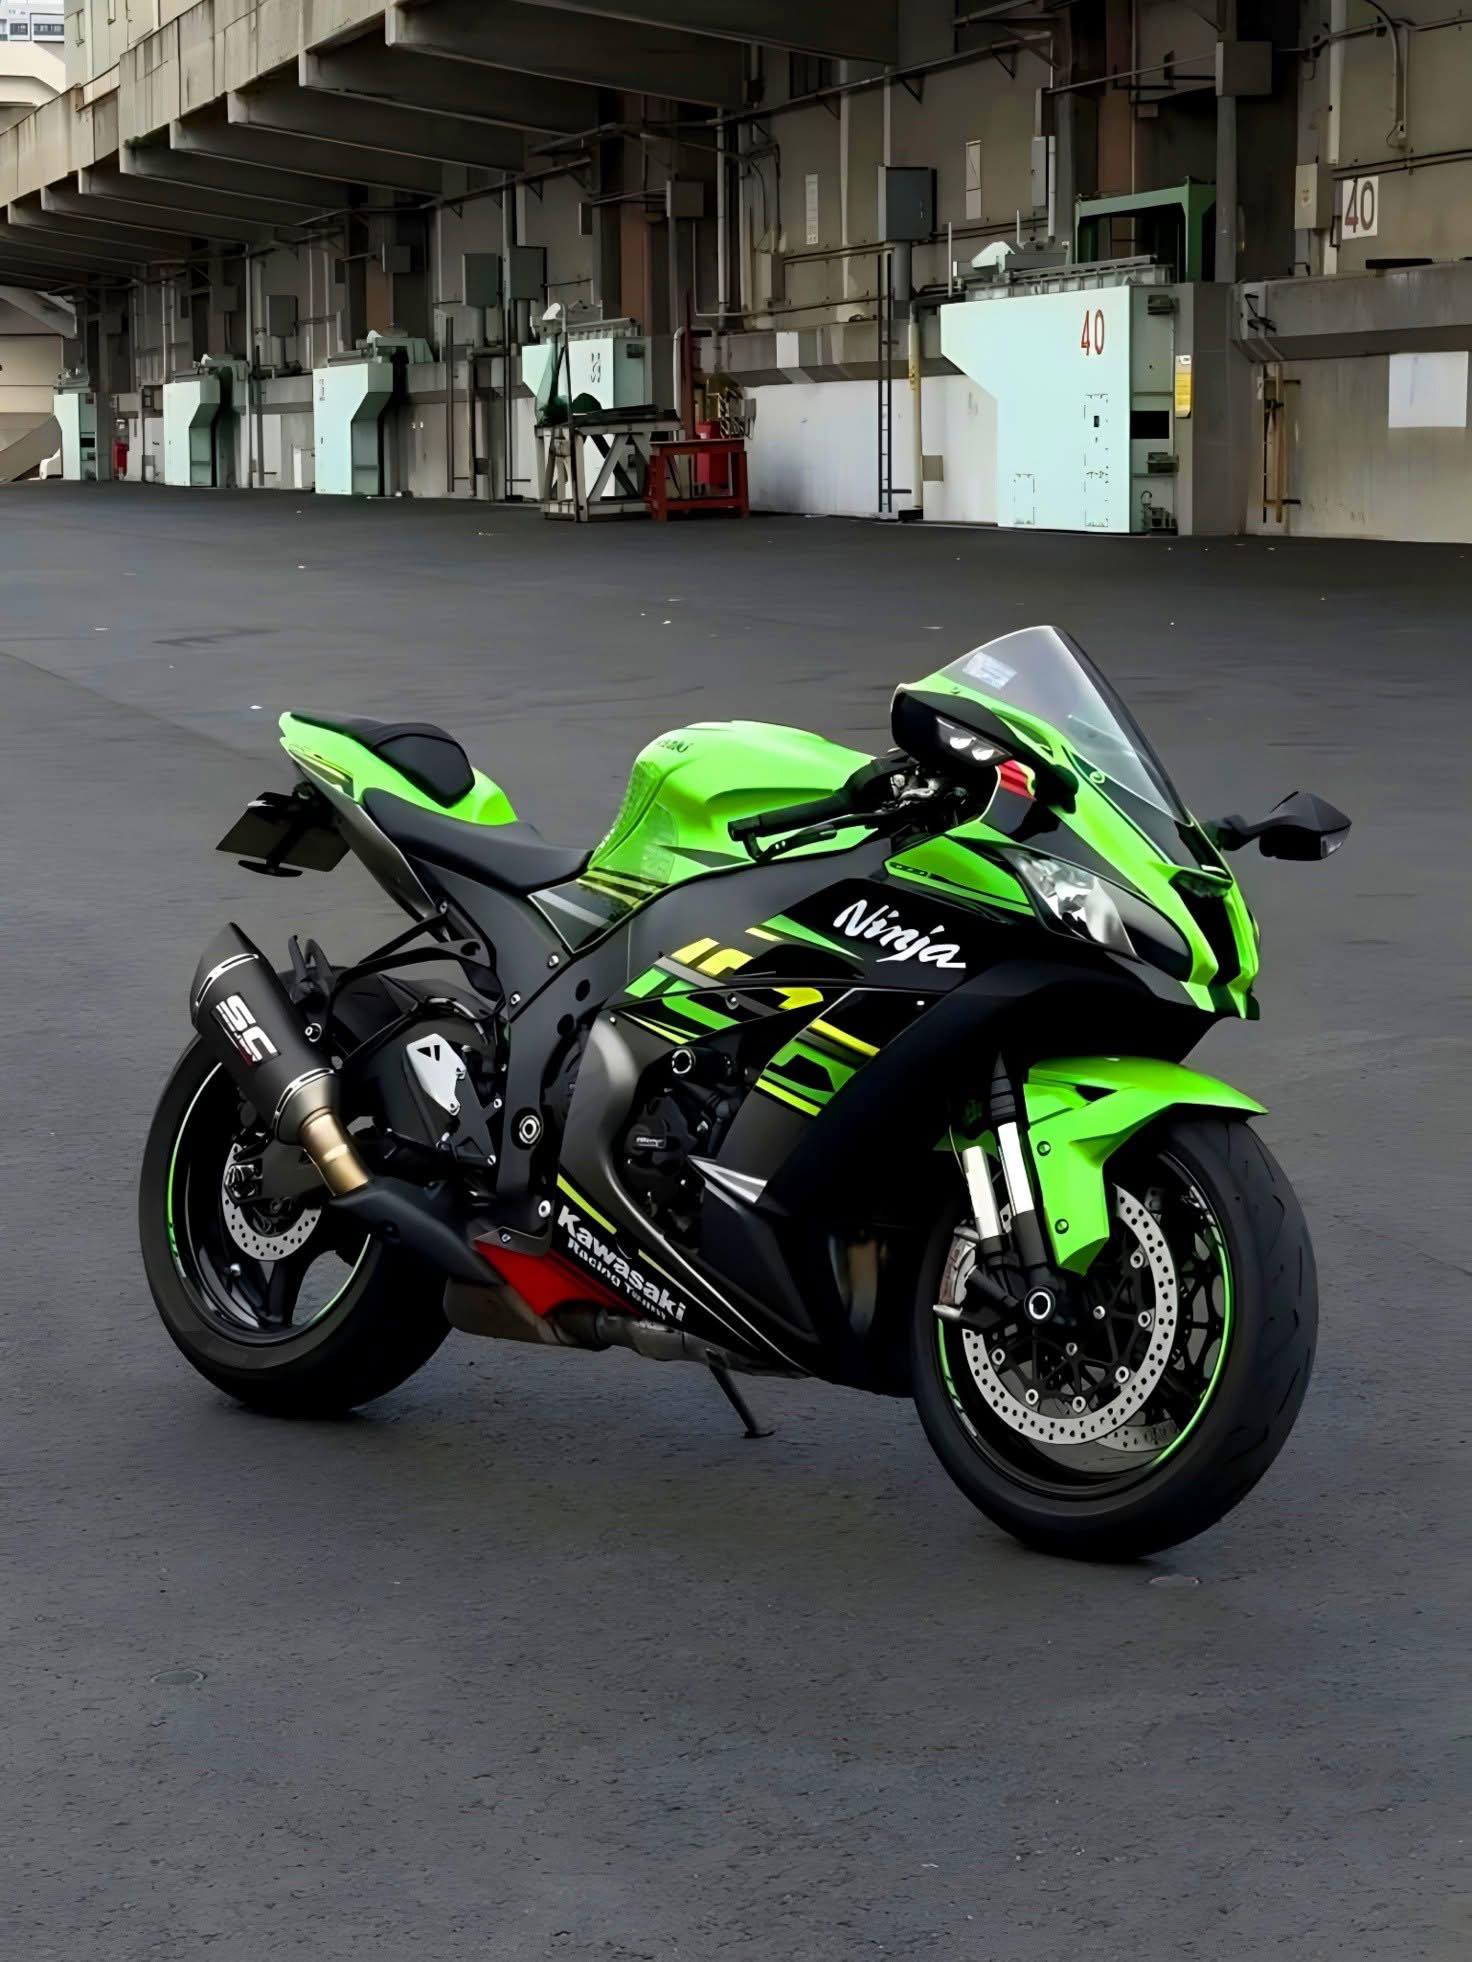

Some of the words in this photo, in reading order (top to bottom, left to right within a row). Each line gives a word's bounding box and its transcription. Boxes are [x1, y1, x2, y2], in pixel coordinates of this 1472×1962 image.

[1345, 179, 1375, 233] 40
[1081, 309, 1105, 356] 40
[833, 899, 967, 969] Ninja
[216, 994, 279, 1062] SC
[558, 1205, 686, 1321] Kawasaki
